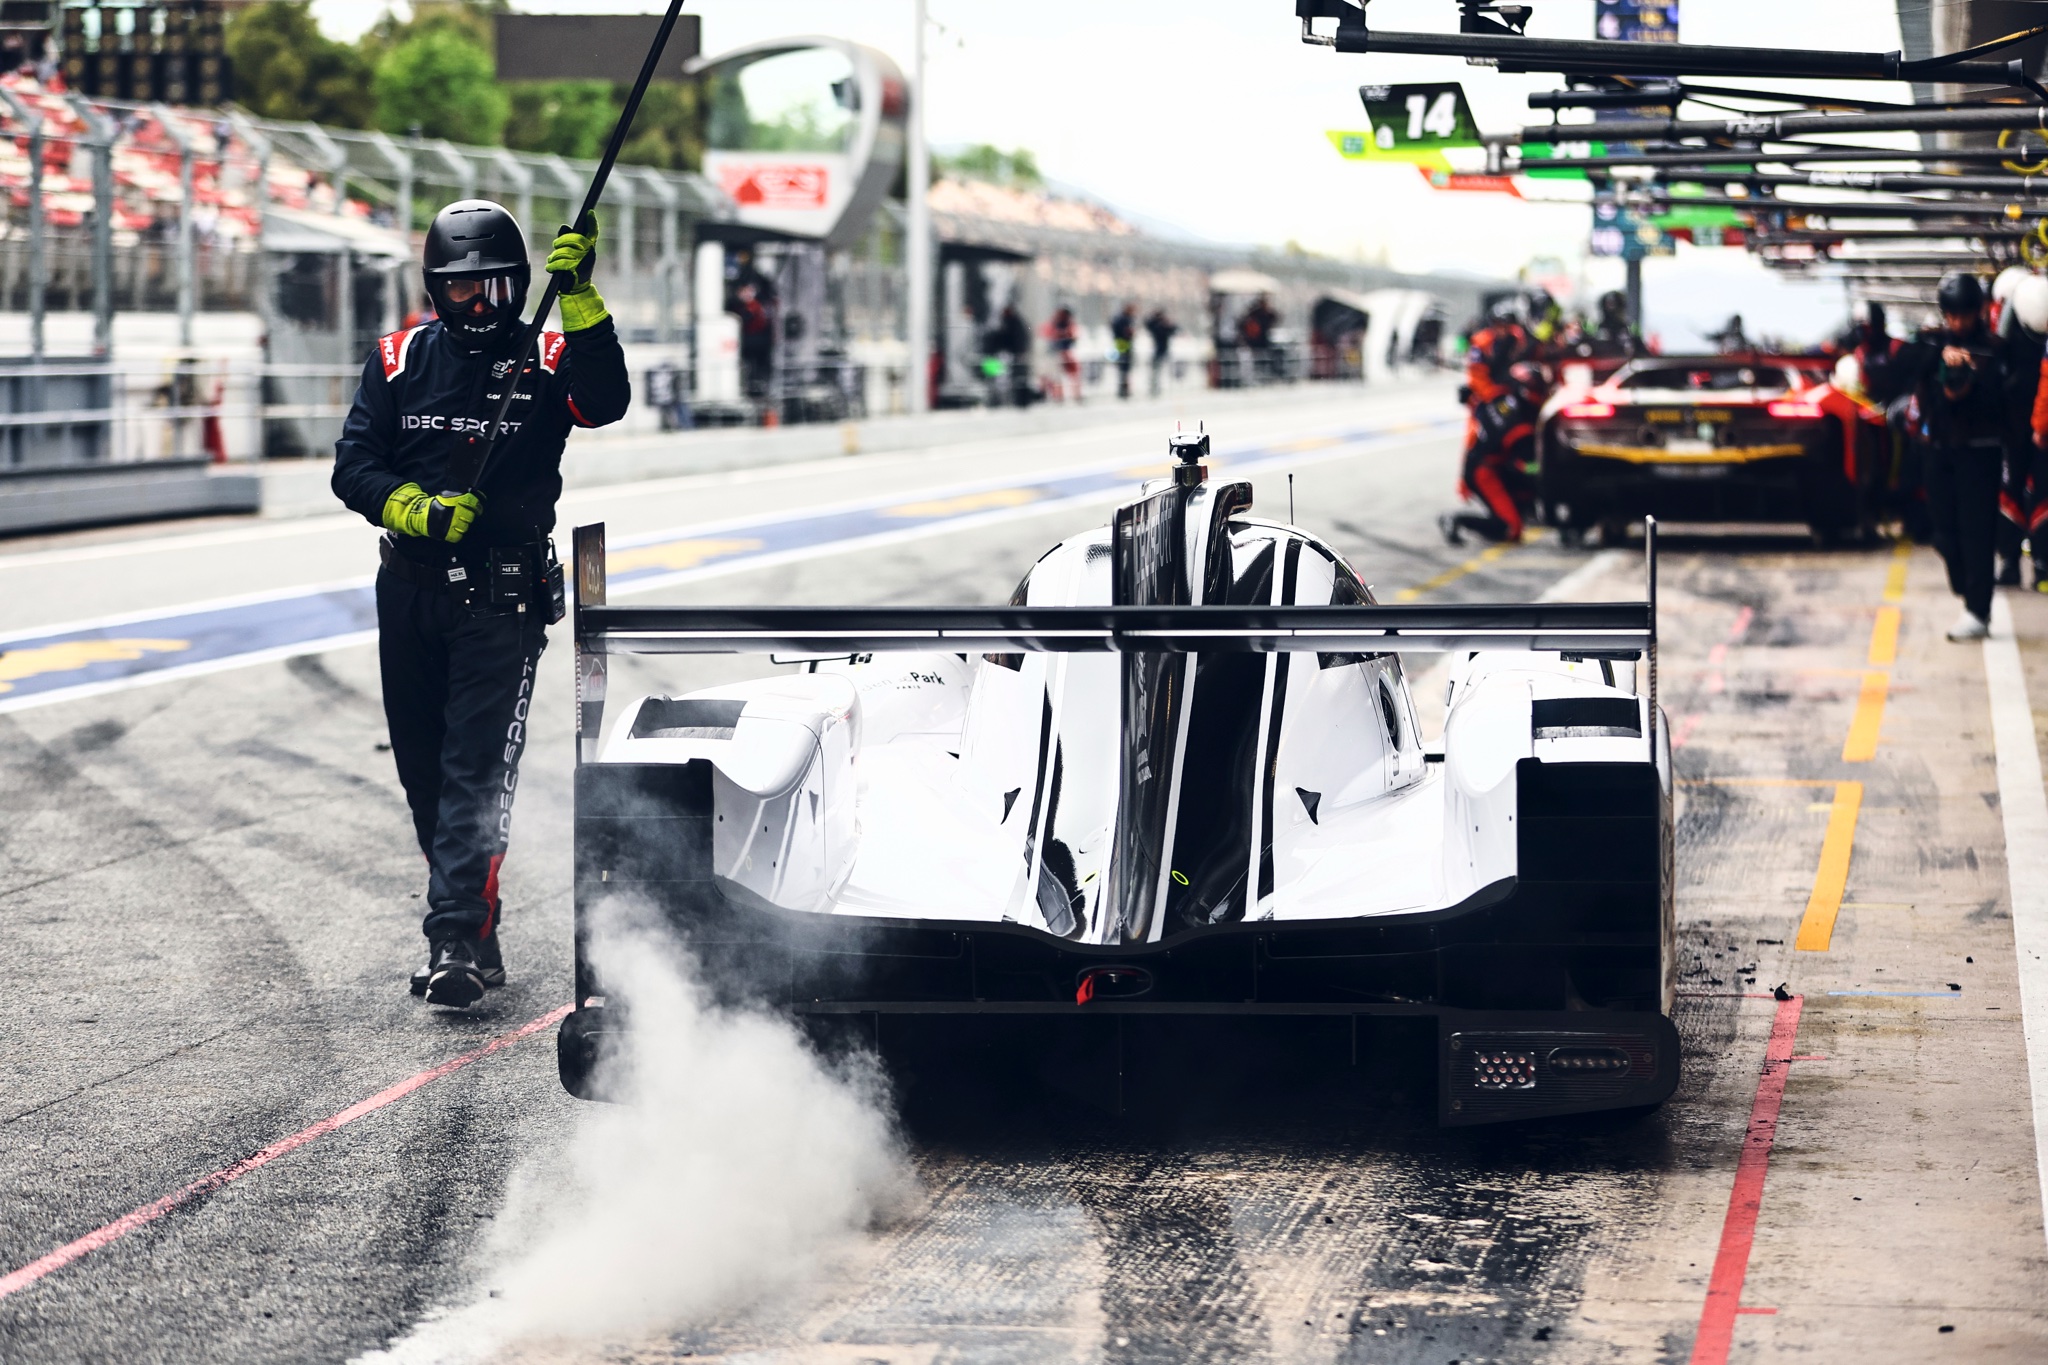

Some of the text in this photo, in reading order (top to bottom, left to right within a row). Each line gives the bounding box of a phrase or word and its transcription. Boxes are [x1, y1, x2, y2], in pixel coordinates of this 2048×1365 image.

[1405, 91, 1457, 140] 14
[382, 335, 397, 366] HRX
[486, 392, 532, 401] GOYEAR
[401, 415, 446, 430] IDEC
[499, 770, 517, 843] IDEC
